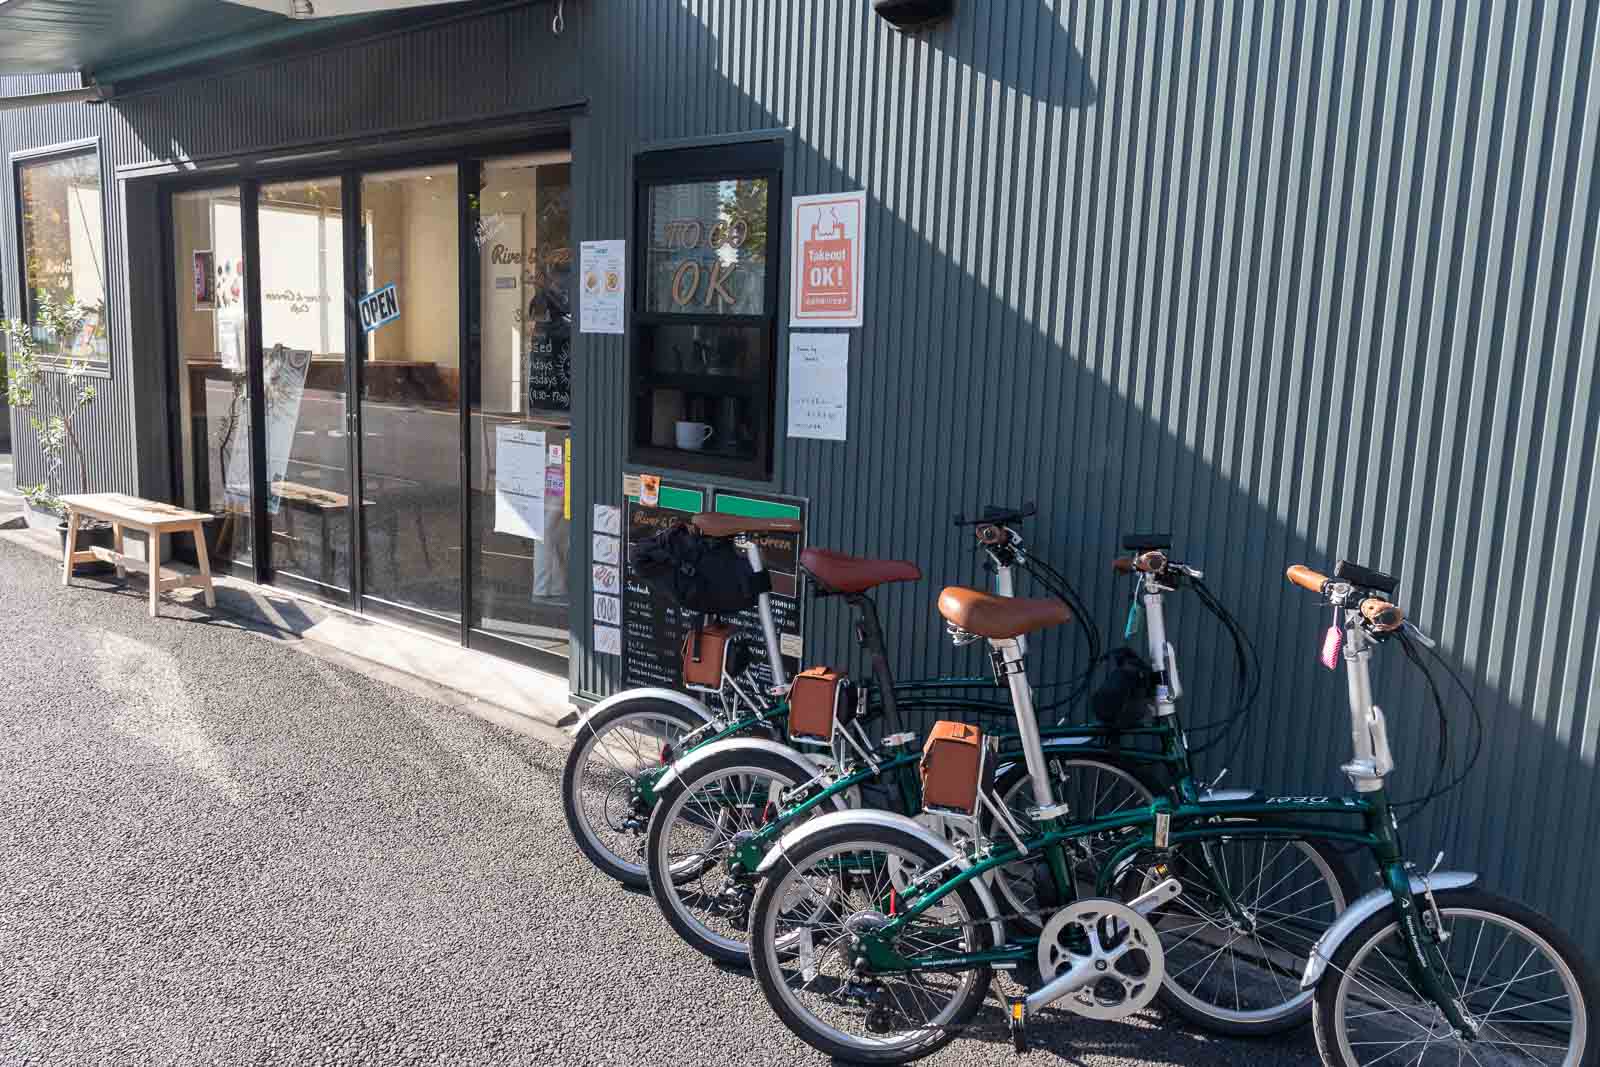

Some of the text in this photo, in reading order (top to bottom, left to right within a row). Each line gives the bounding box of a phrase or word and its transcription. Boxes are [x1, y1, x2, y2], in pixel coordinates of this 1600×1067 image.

[664, 219, 700, 249] TO
[672, 259, 737, 306] OK
[810, 266, 844, 288] OK!
[361, 286, 398, 326] OPEN
